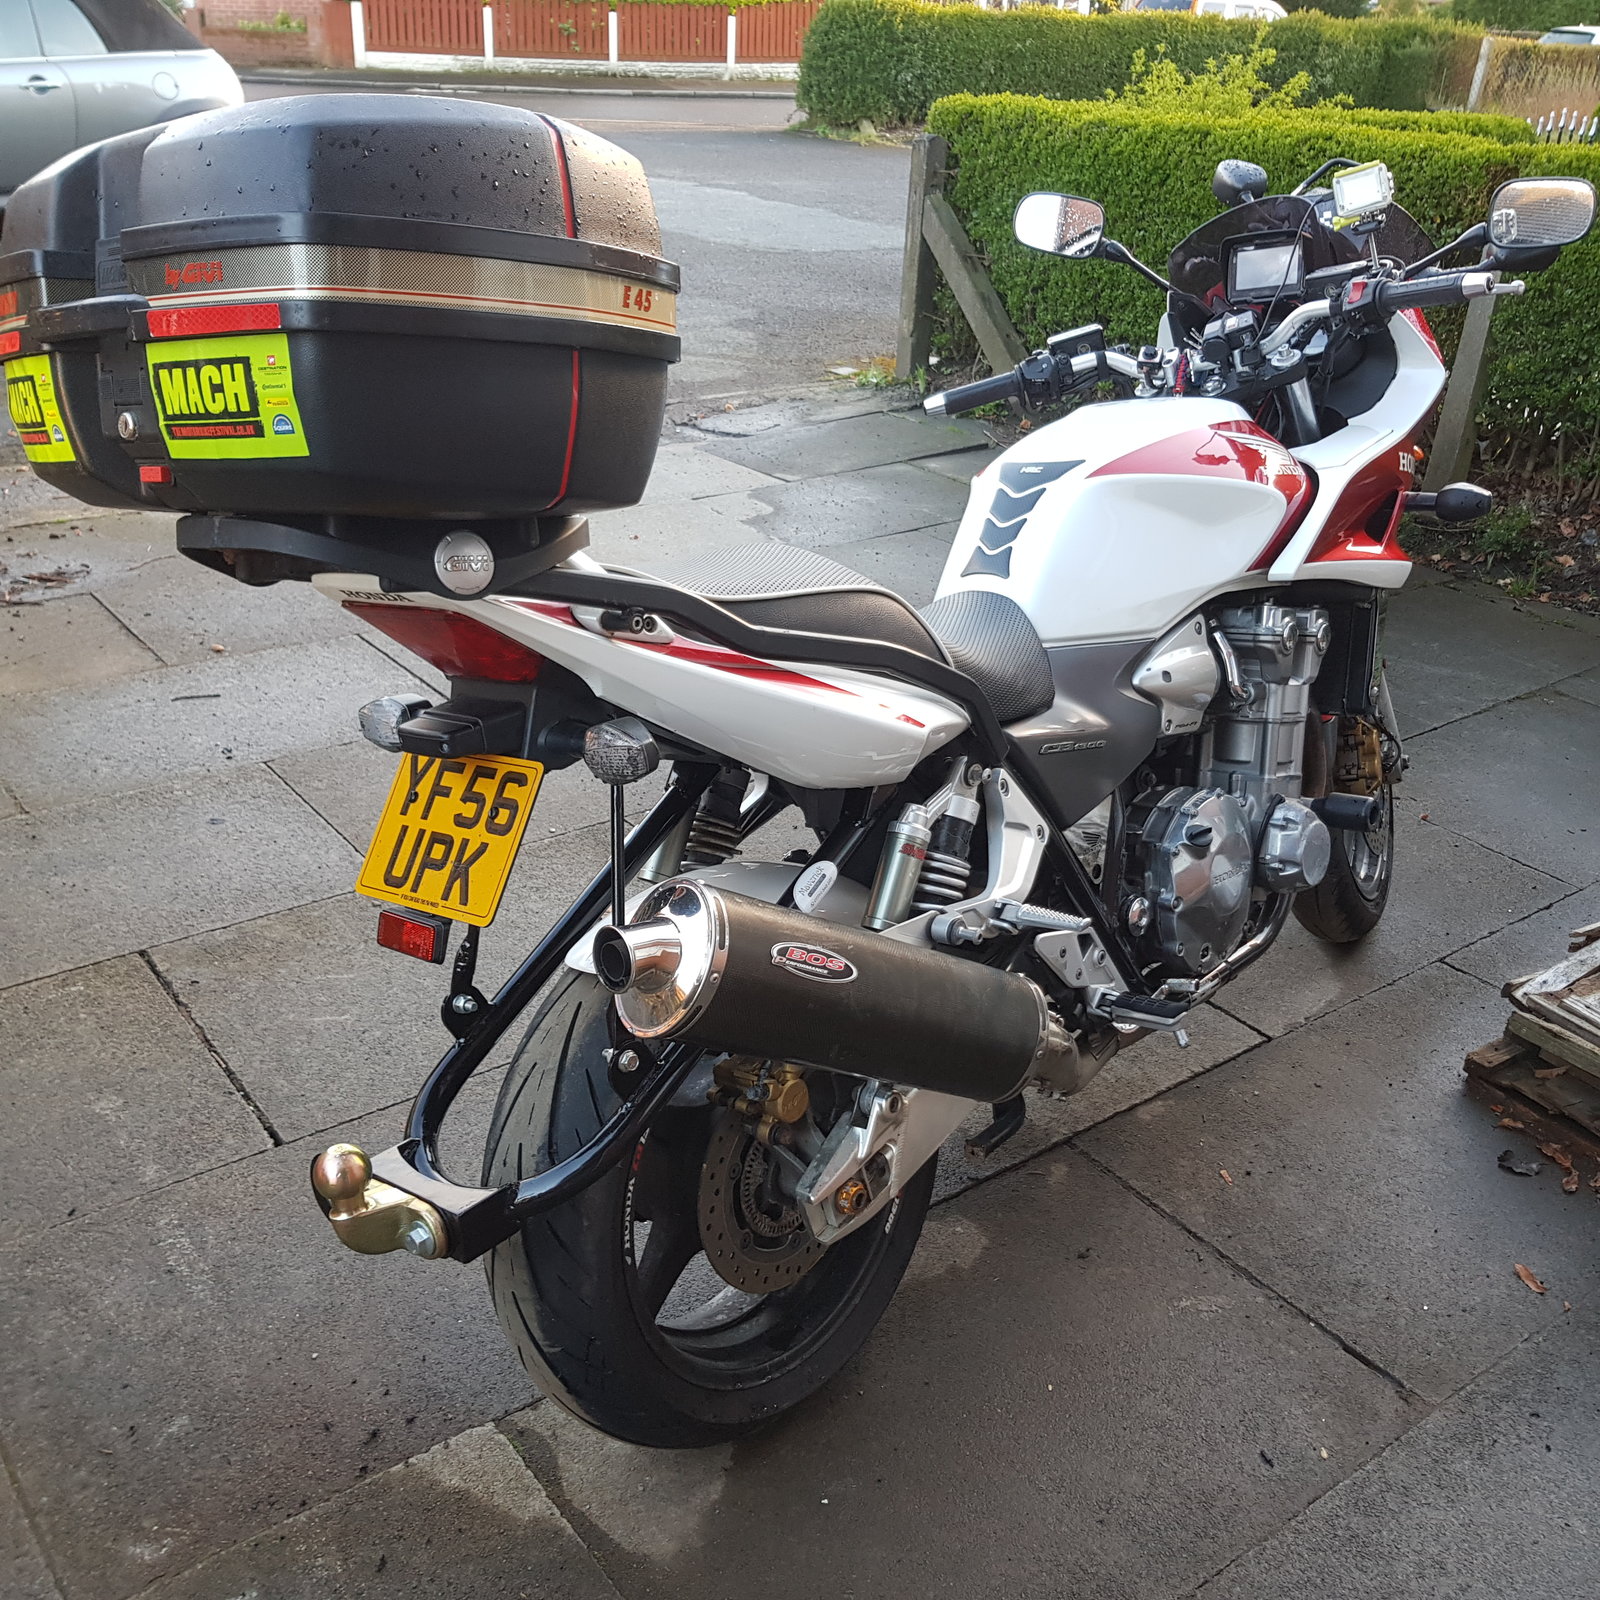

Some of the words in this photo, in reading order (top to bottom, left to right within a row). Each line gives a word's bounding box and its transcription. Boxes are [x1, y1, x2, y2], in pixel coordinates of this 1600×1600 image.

[181, 261, 223, 284] GIVI
[622, 285, 631, 308] E
[634, 288, 652, 312] 45
[9, 381, 42, 424] MACH
[159, 363, 250, 415] MACH
[444, 555, 489, 572] GIVI
[339, 589, 415, 603] HONDA
[399, 755, 529, 837] YF56
[383, 824, 489, 907] UPK
[773, 955, 829, 974] PERFORMANCE
[785, 946, 846, 971] BOS
[624, 1176, 636, 1249] HONDA
